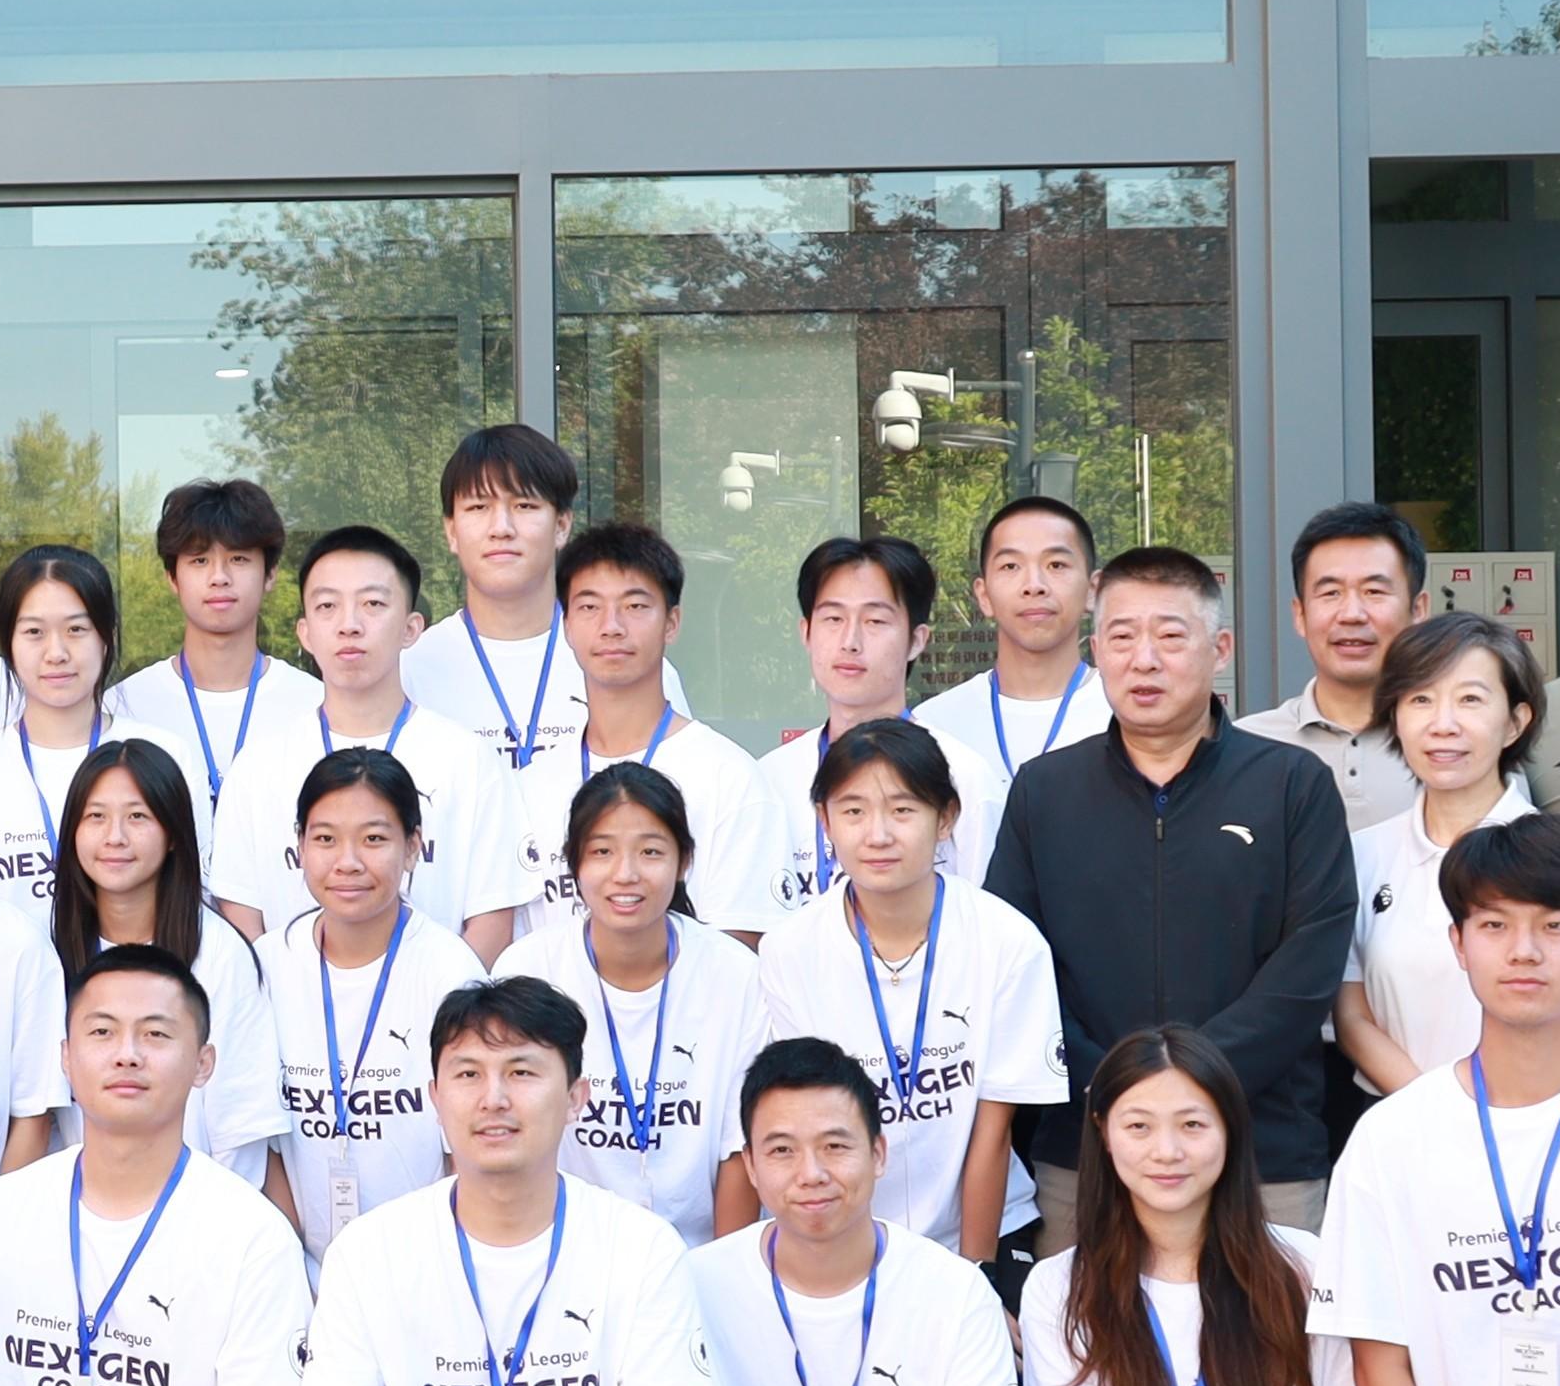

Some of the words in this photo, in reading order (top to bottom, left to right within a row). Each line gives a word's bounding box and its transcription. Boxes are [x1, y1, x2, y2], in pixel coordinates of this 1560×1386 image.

[921, 1041, 967, 1060] eague
[880, 1097, 953, 1125] OACH
[1447, 1225, 1507, 1247] Premie
[17, 1309, 72, 1332] Premier
[104, 1326, 152, 1348] League
[435, 1355, 494, 1373] Premie
[530, 1347, 590, 1369] League
